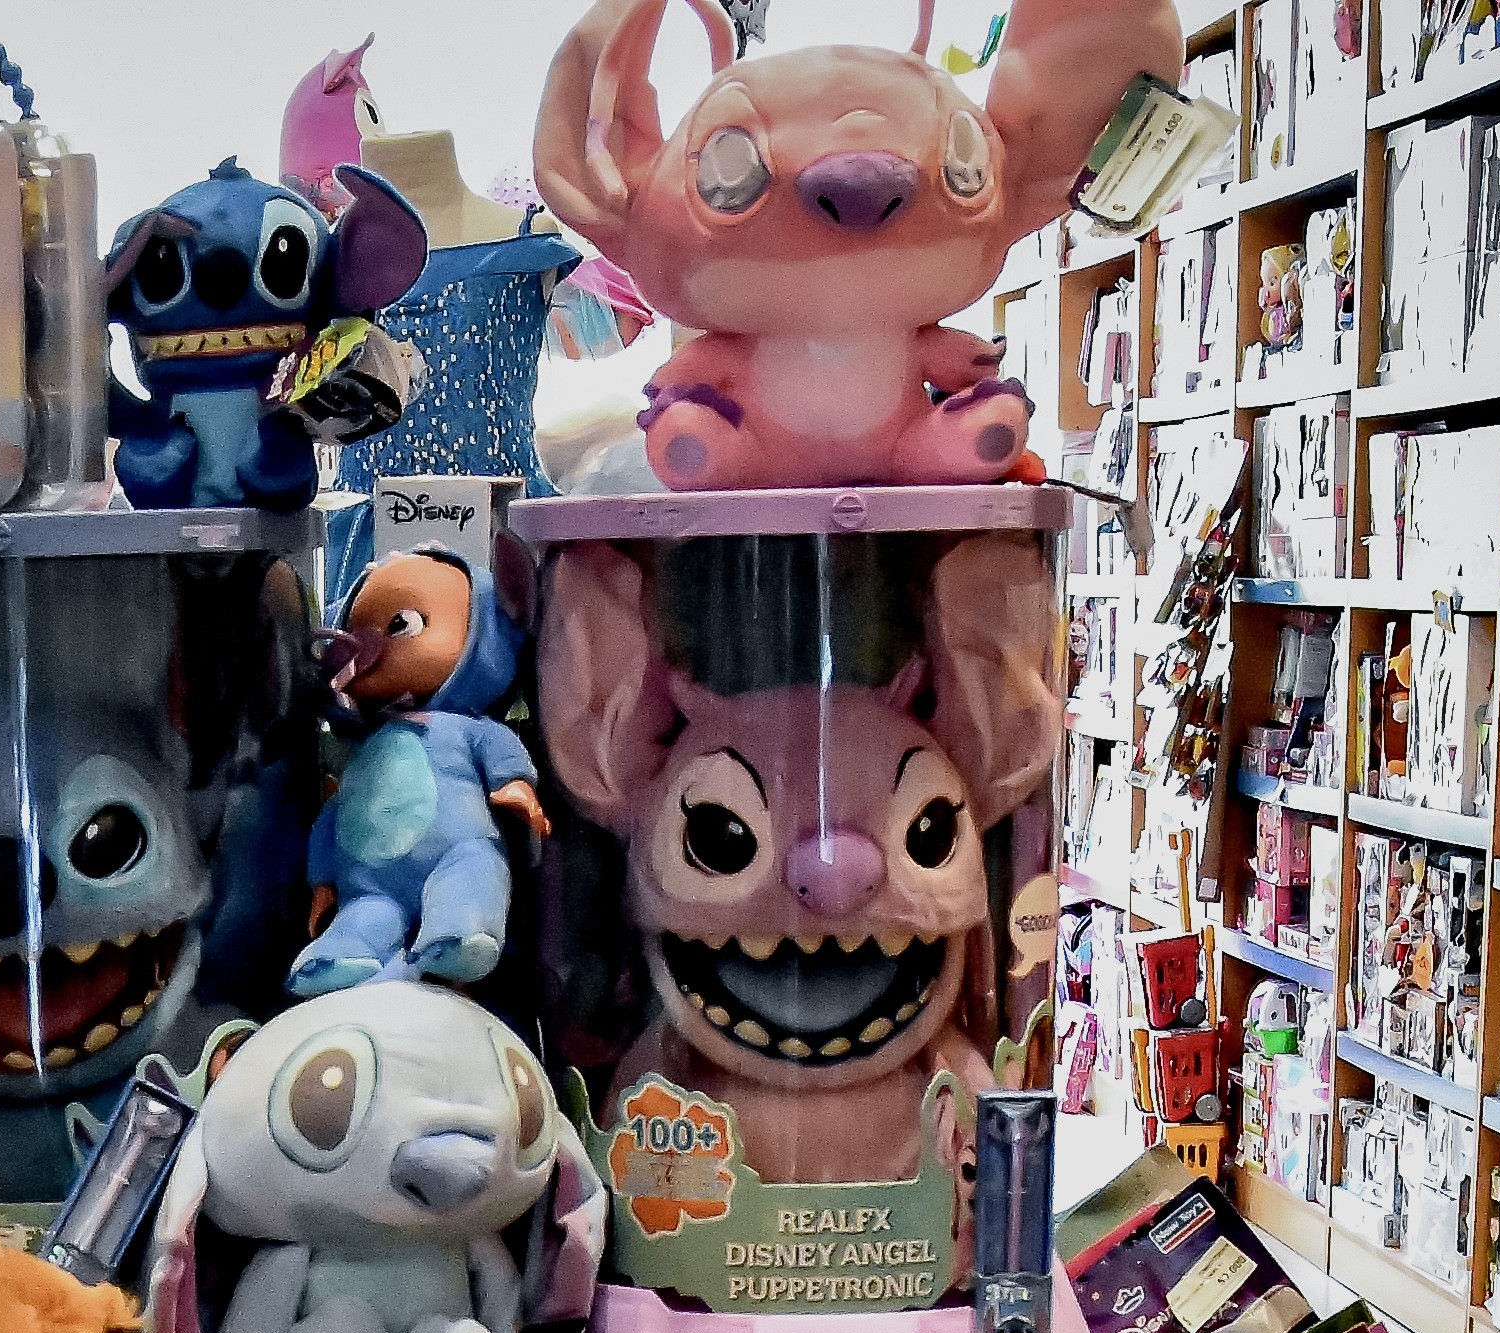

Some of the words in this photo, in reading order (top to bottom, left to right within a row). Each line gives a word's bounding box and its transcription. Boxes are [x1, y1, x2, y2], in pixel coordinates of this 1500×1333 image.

[629, 1115, 719, 1153] 100+
[777, 1205, 894, 1235] REALFX
[724, 1239, 836, 1268] DISNEY
[839, 1237, 937, 1266] ANGEL
[727, 1271, 936, 1303] PUPPETRONIC
